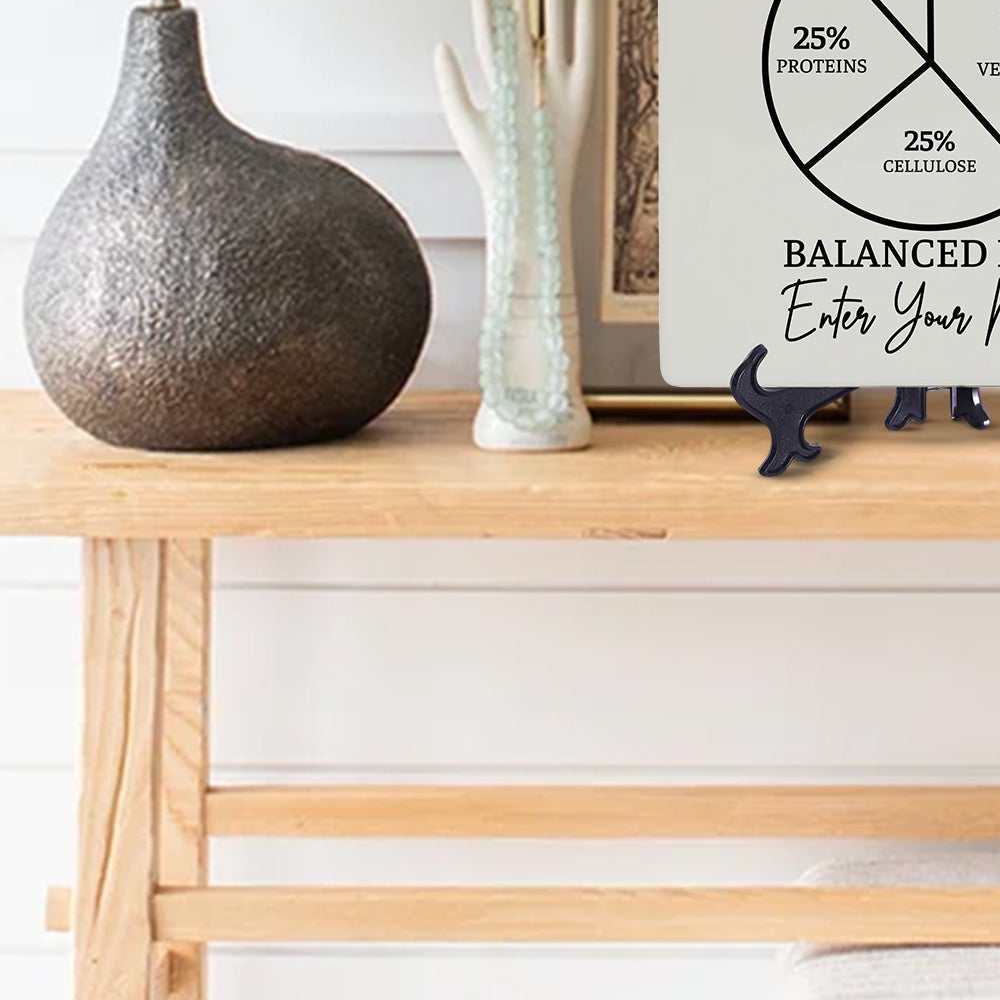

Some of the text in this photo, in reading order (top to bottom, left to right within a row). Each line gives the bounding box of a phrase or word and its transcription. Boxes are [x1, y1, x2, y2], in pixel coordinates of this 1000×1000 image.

[793, 25, 851, 50] 25%
[776, 58, 868, 74] PROTEINS
[904, 129, 956, 152] 25%
[883, 159, 977, 173] CELLULOSE
[783, 238, 988, 268] BALANCED
[780, 277, 877, 343] Enter
[884, 280, 973, 355] Your
